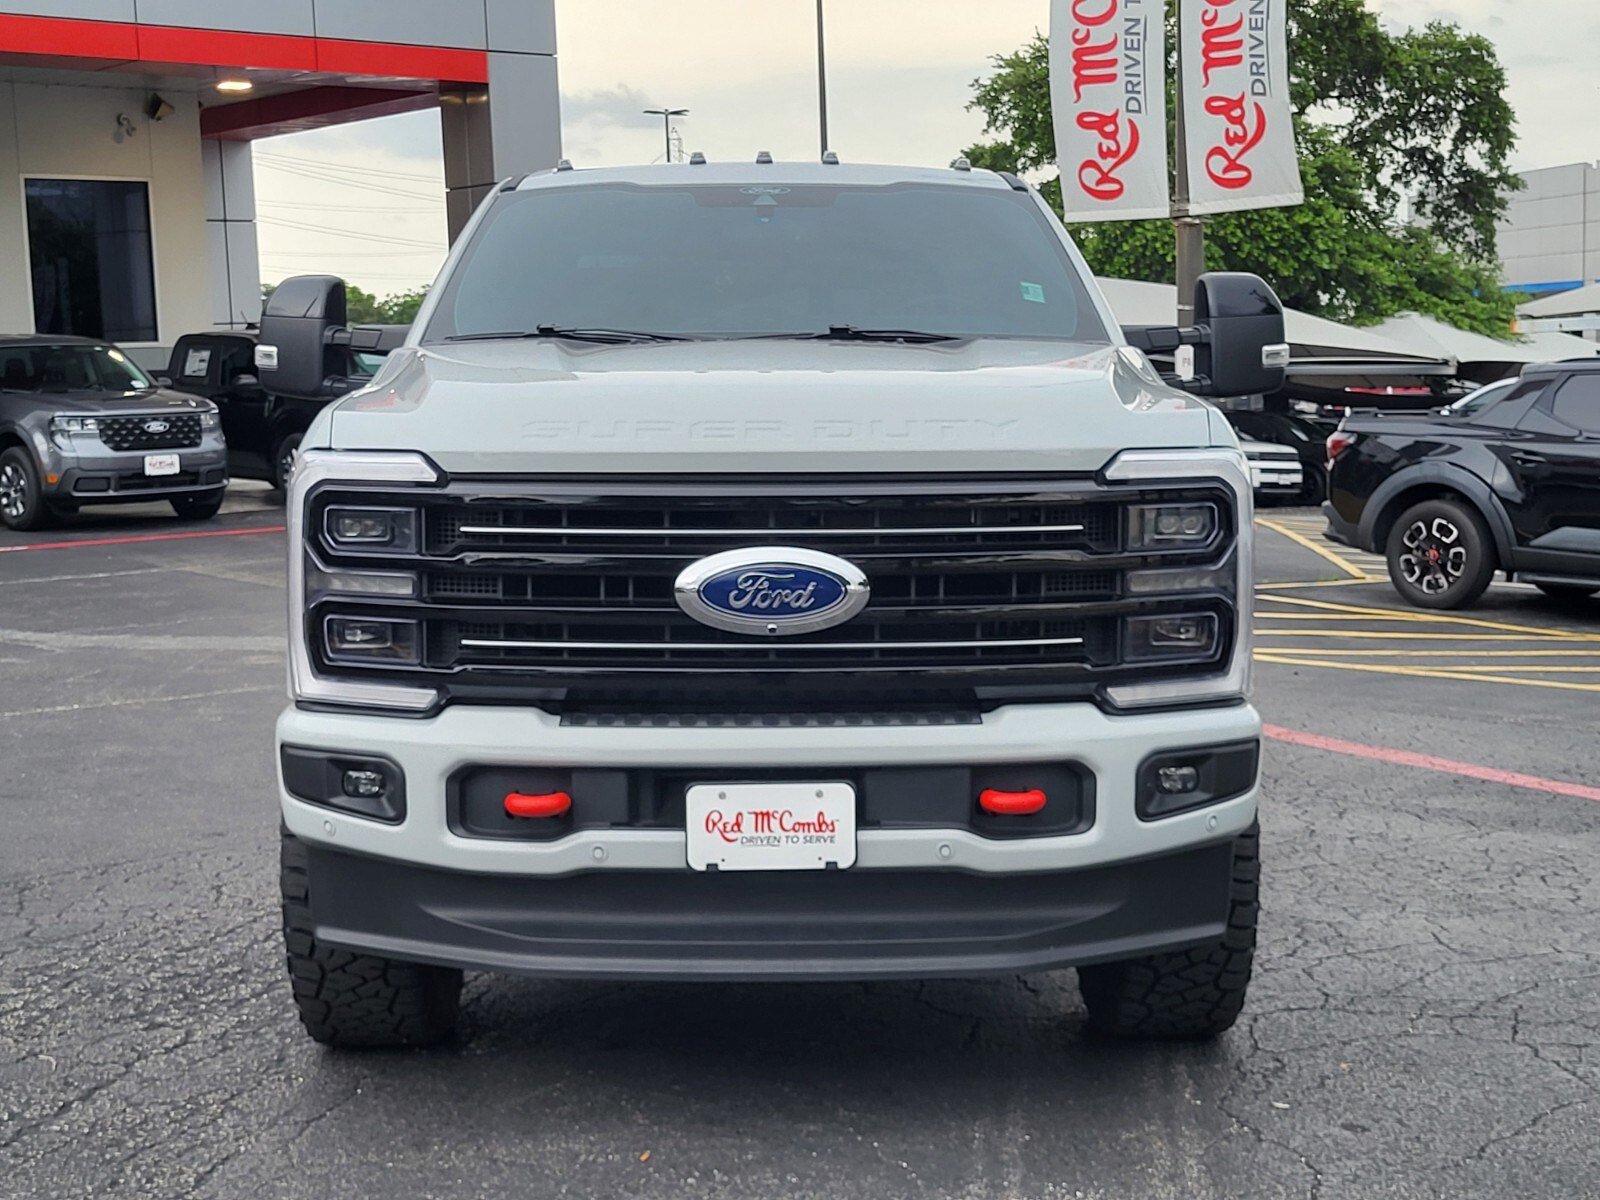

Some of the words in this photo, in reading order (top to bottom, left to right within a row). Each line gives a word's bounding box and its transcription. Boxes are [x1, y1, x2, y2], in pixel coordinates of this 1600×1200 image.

[1123, 18, 1141, 114] DRIVEN
[1201, 0, 1244, 88] Mc
[1249, 0, 1267, 97] DRIVEN
[1076, 108, 1140, 200] Red
[1204, 91, 1266, 189] Red
[520, 418, 796, 439] SUPER
[811, 418, 1020, 440] DUTY
[729, 572, 817, 609] Ford
[705, 810, 743, 842] Red
[748, 810, 836, 834] McCombs
[740, 835, 781, 845] DRIVEN
[785, 835, 800, 844] TO
[802, 834, 836, 844] SERVE
